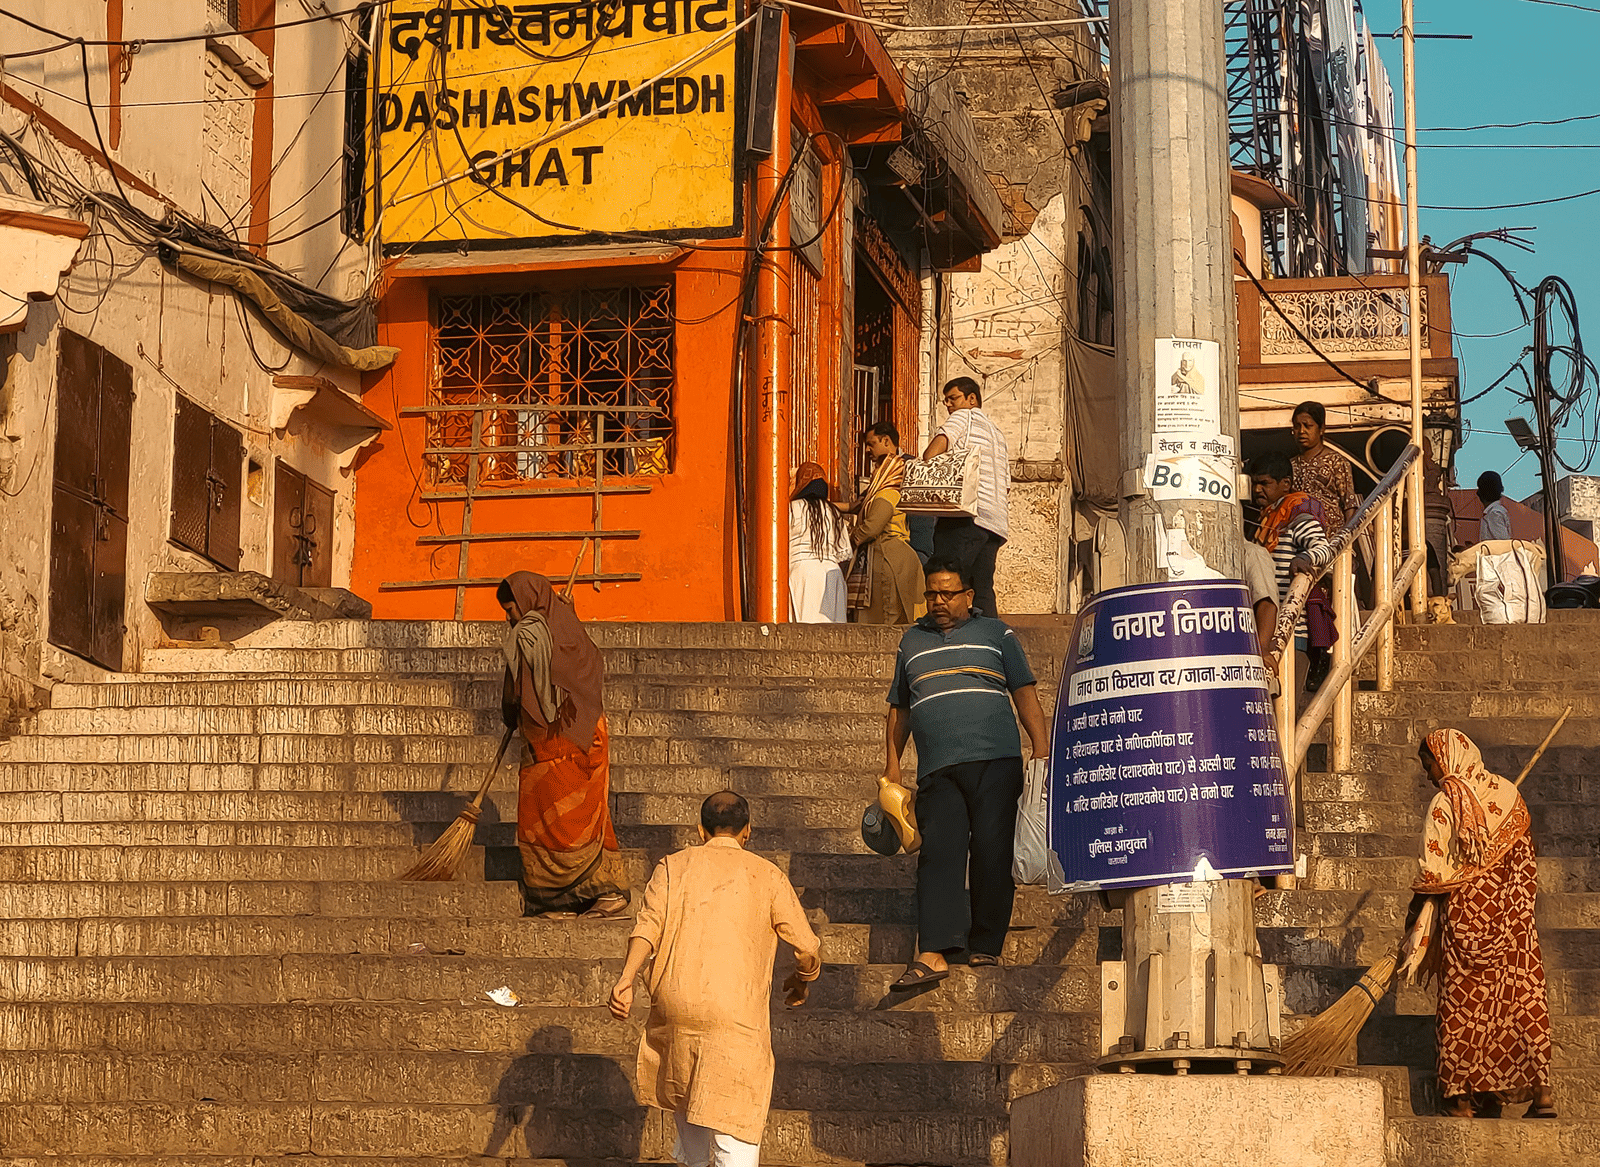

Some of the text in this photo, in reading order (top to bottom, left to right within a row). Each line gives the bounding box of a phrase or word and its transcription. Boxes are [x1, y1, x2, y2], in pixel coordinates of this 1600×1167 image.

[379, 74, 725, 133] DASHASHWMEDH
[469, 146, 604, 187] GHAT
[1172, 340, 1202, 350] लापता
[1159, 438, 1183, 454] सैलून
[1189, 441, 1197, 450] व
[1111, 610, 1166, 641] नगर
[1171, 599, 1235, 636] निगम
[1077, 680, 1092, 697] नाव
[1095, 677, 1109, 693] का
[1112, 670, 1155, 691] किराया
[1101, 709, 1107, 726] से
[1109, 706, 1126, 724] नमो
[1127, 709, 1143, 722] घाट
[1101, 740, 1114, 753] घाट
[1115, 734, 1123, 751] से
[1125, 730, 1175, 750] मणिकर्णिका
[1177, 732, 1194, 746] घाट
[1187, 755, 1196, 773] से
[1199, 754, 1221, 772] अस्सी
[1222, 757, 1236, 771] घाट
[1190, 783, 1198, 801] से
[1200, 782, 1219, 800] नमो
[1220, 785, 1234, 799] घाट
[1089, 838, 1147, 858] पुलिस आयुक्त
